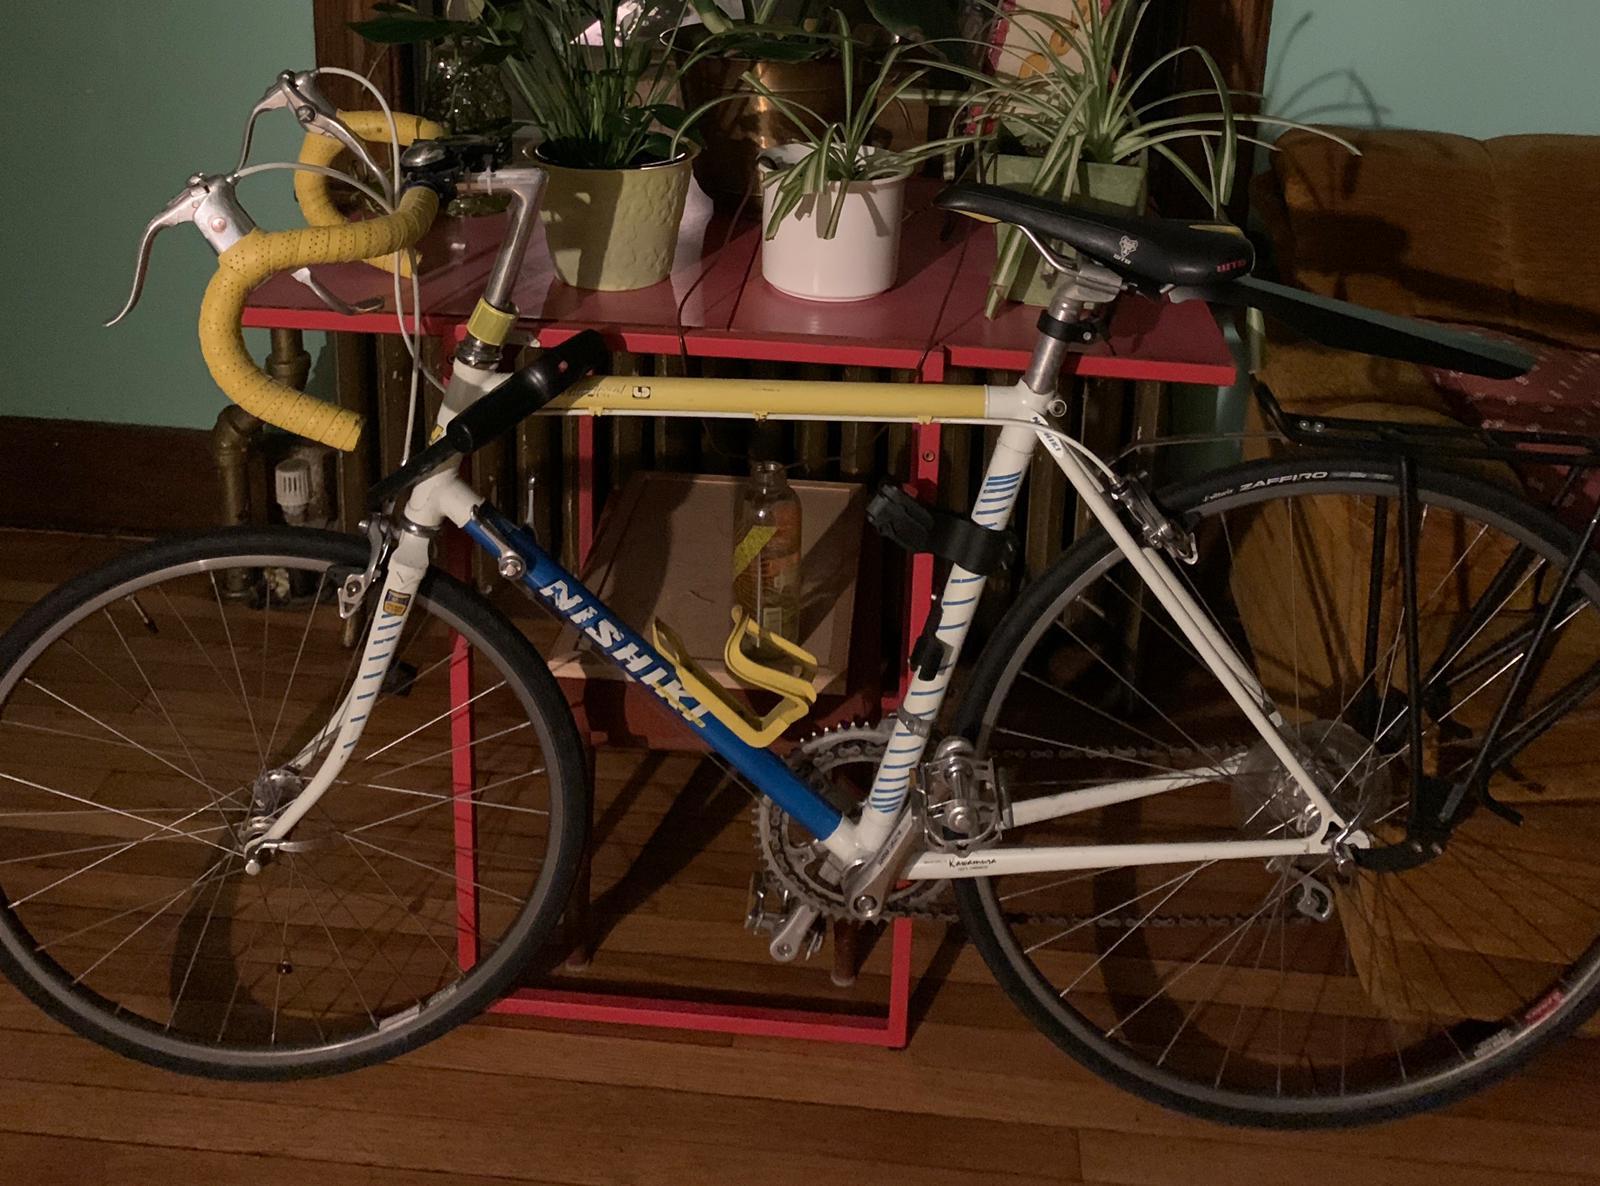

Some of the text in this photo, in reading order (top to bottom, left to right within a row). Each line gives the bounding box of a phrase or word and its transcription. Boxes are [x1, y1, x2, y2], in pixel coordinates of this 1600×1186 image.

[1032, 416, 1062, 451] NHIKI
[1239, 471, 1328, 491] ZAFFIRO
[540, 580, 710, 722] NISHIKI
